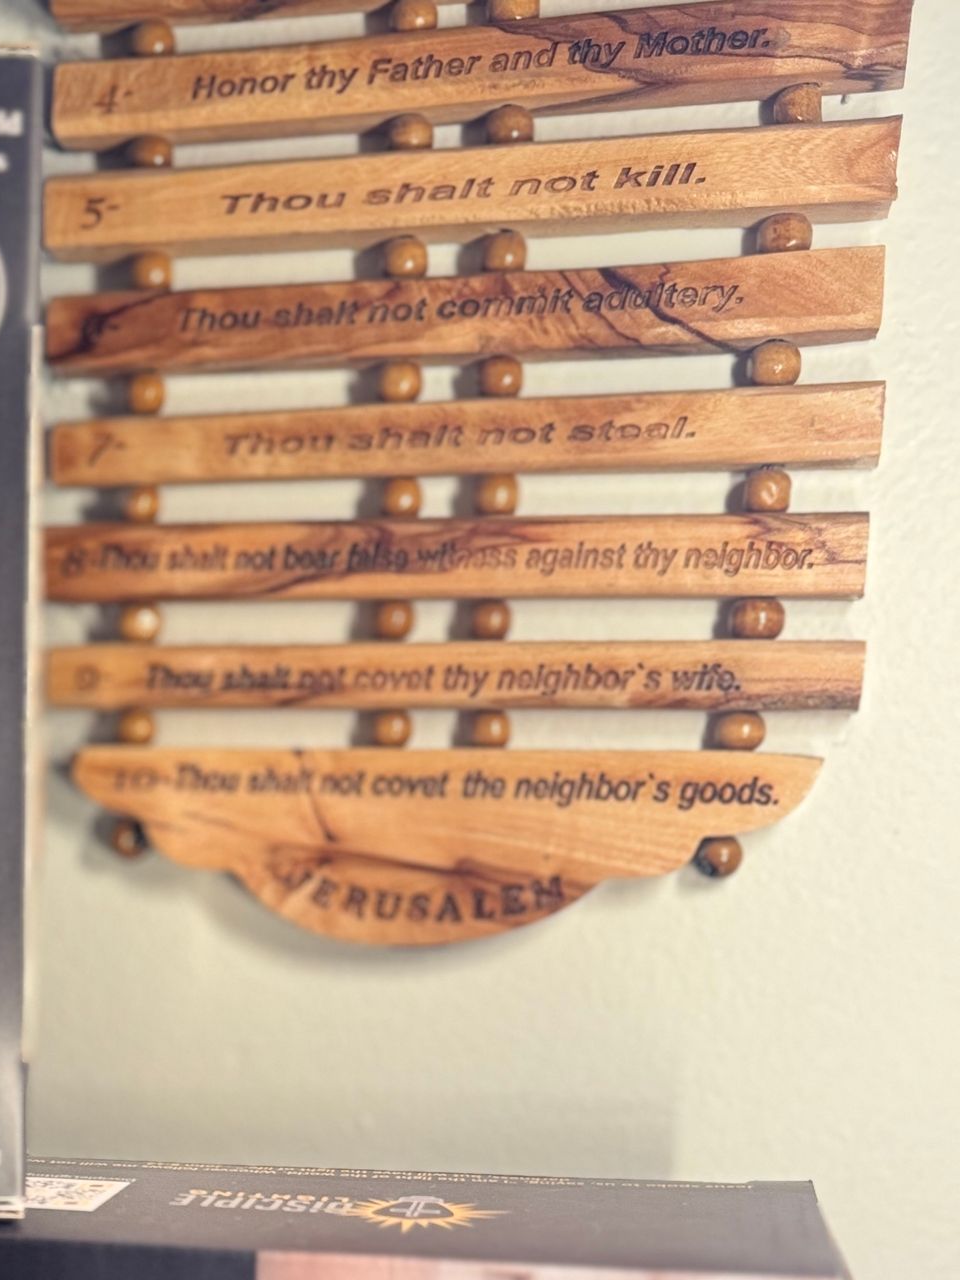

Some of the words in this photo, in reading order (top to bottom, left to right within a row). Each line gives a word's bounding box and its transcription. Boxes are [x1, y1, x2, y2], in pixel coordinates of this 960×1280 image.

[192, 71, 295, 100] Honor
[304, 64, 358, 95] thy
[367, 50, 481, 85] Father
[489, 42, 559, 72] and
[567, 35, 626, 68] thy
[634, 25, 771, 60] Mother.
[221, 192, 346, 216] Thou
[364, 177, 496, 207] shalt
[507, 169, 610, 197] not
[614, 162, 707, 190] kill.
[178, 307, 260, 333] Thou
[274, 300, 358, 328] shalt
[367, 300, 427, 325] not
[436, 288, 576, 319] commit
[581, 283, 744, 314] adultery.
[223, 432, 337, 457] Thou
[347, 424, 464, 452] shalt
[476, 419, 553, 447] not
[566, 416, 697, 443] steal.
[168, 544, 228, 571] shalt
[234, 545, 276, 572] not
[282, 544, 340, 572] bear
[346, 541, 409, 573] false
[416, 540, 517, 569] witness
[525, 541, 626, 577] against
[634, 541, 677, 577] thy
[683, 539, 814, 577] neighbor.
[147, 663, 213, 691] Thou
[221, 664, 292, 691] shalt
[298, 666, 346, 693] not
[353, 664, 434, 692] covet
[442, 663, 490, 698] thy
[671, 665, 742, 694] wife.
[174, 763, 239, 792] Thou
[247, 765, 314, 795] shalt
[320, 768, 364, 797] not
[371, 768, 450, 799] covet
[462, 770, 504, 799] the
[678, 776, 779, 810] goods.
[282, 870, 567, 924] JERUSALEM
